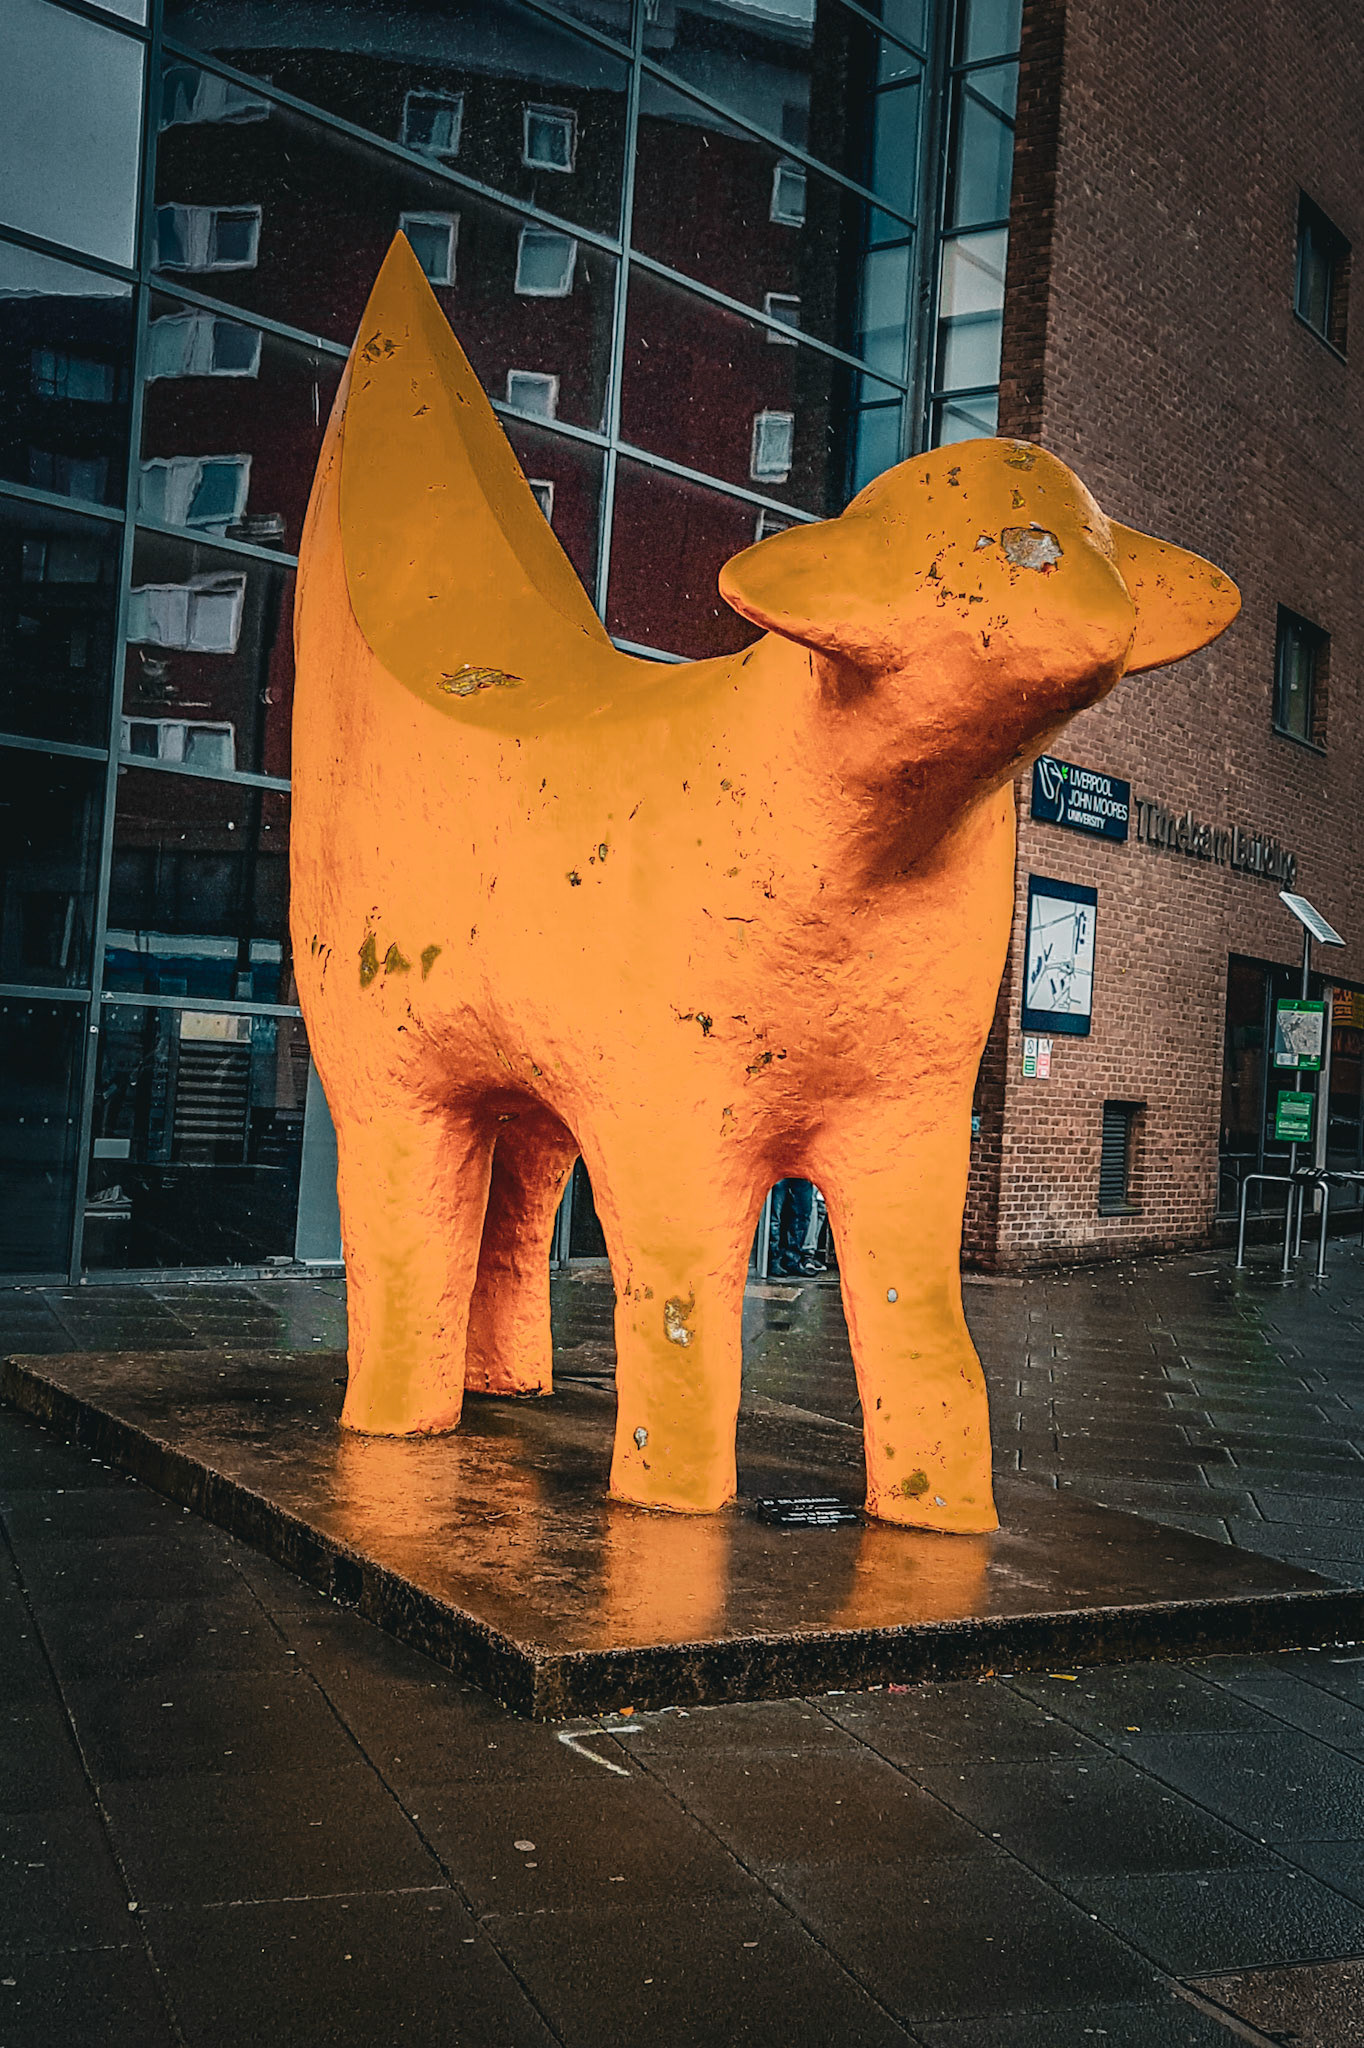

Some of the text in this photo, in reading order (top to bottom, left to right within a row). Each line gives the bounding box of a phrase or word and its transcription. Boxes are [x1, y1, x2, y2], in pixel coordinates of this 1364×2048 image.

[1070, 768, 1113, 797] LIVERPOOL
[1067, 808, 1106, 829] UNIVERSITY
[1068, 789, 1128, 821] JOHN MOORES
